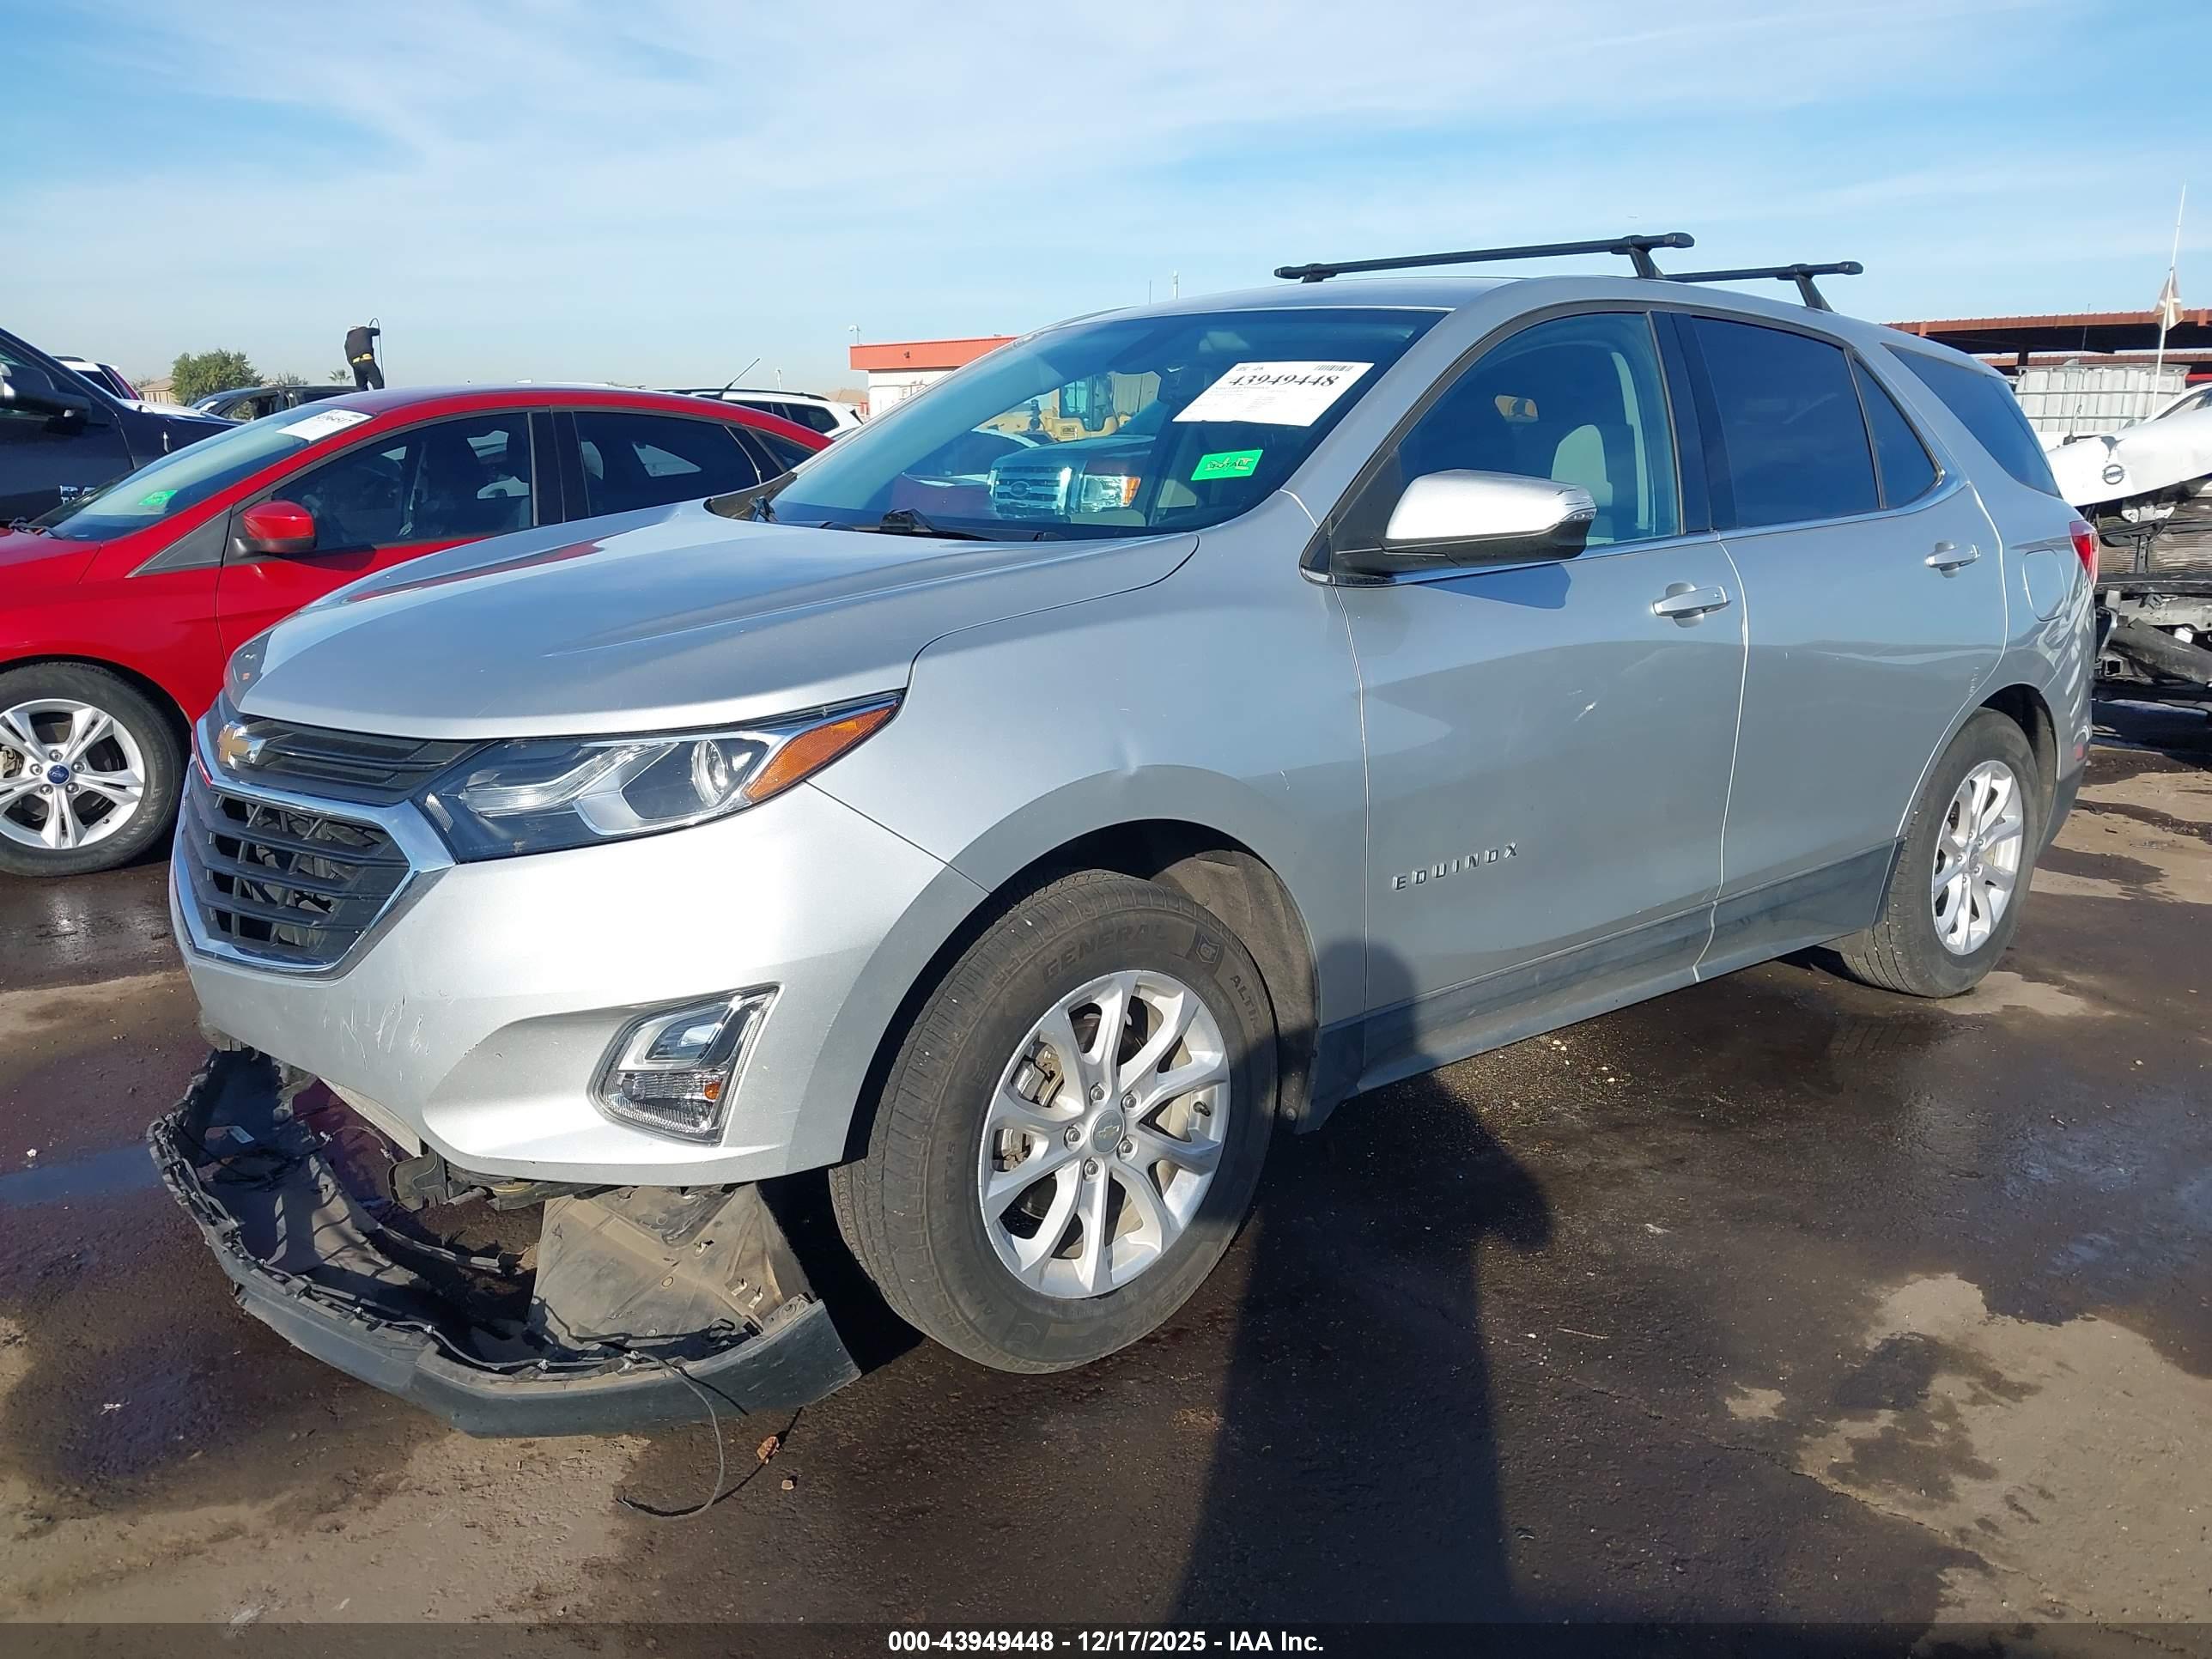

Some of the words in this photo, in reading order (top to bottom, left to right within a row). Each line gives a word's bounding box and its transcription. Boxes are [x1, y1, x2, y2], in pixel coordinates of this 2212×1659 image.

[1230, 374, 1340, 386] 43949448
[1392, 842, 1517, 890] EQUINOX
[1043, 924, 1169, 978] GENERAL
